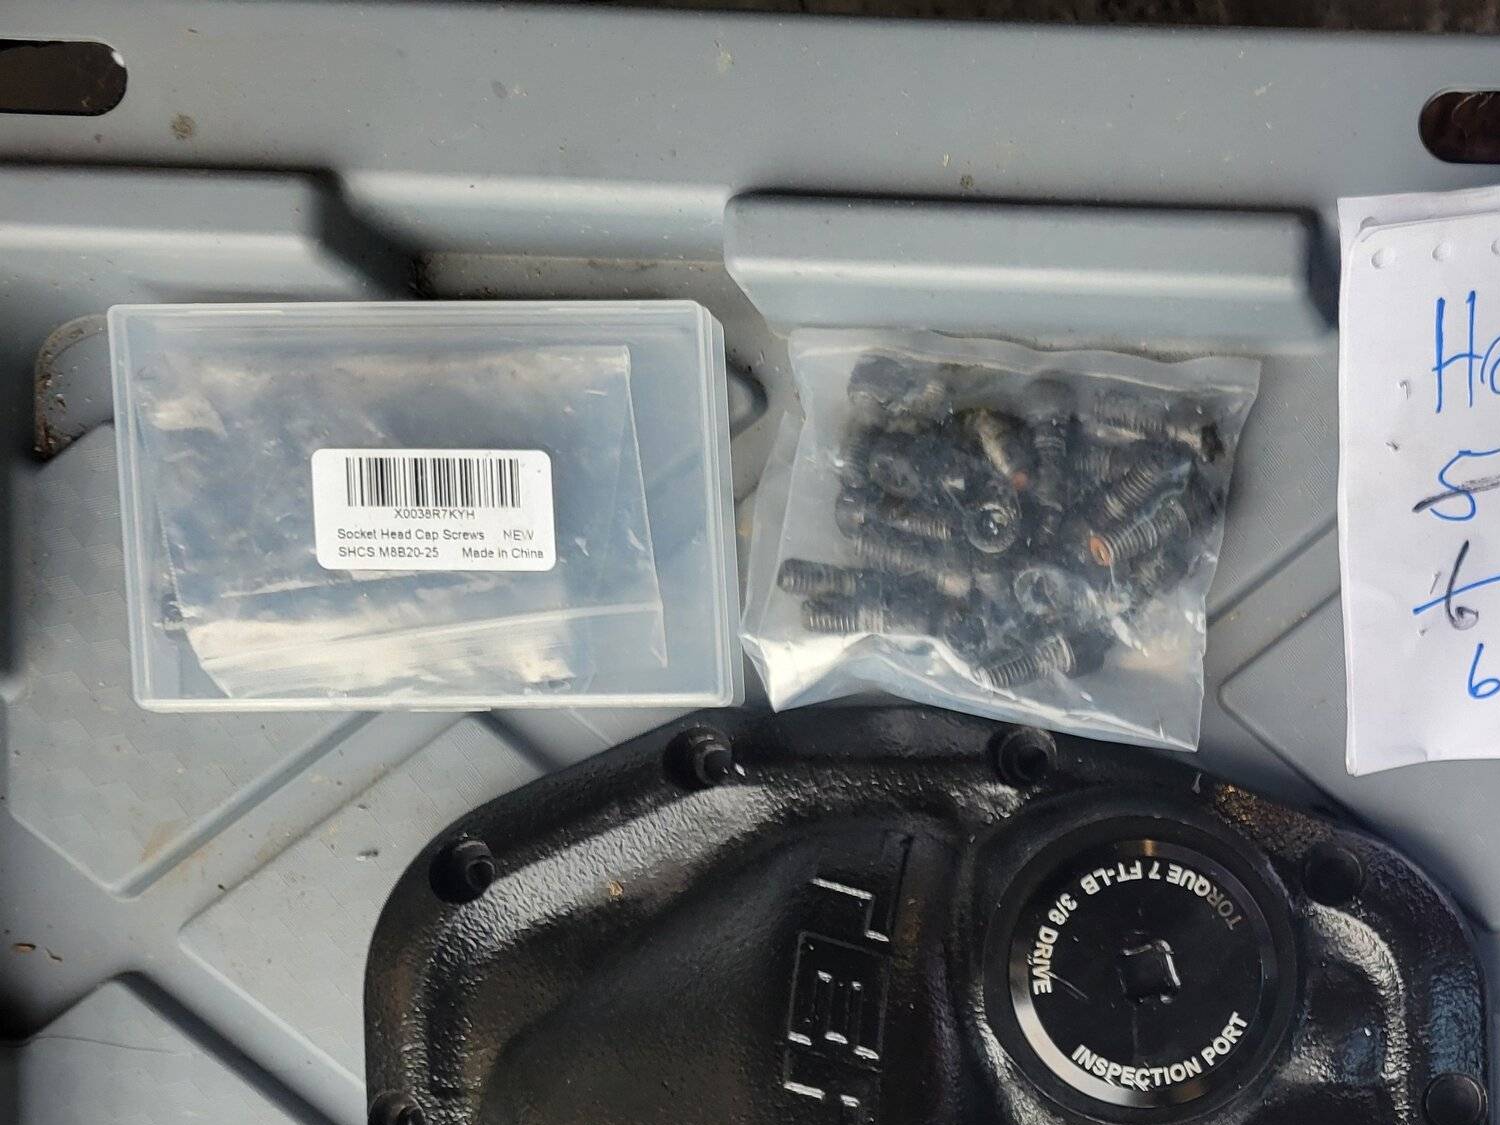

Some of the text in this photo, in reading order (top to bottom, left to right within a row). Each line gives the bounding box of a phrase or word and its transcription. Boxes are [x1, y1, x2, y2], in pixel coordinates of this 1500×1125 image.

[394, 508, 475, 520] X0038R7KYH
[337, 528, 534, 542] Socket Head Cap Screws NEW
[338, 546, 375, 558] SHCS
[462, 547, 494, 559] Made
[511, 547, 544, 559] China
[1080, 860, 1142, 895] FT-LB
[1048, 893, 1078, 926] 3/8
[1166, 863, 1242, 930] TORQUE
[1032, 925, 1059, 995] DRIVE
[1071, 1011, 1248, 1088] INSPECTION PORT
